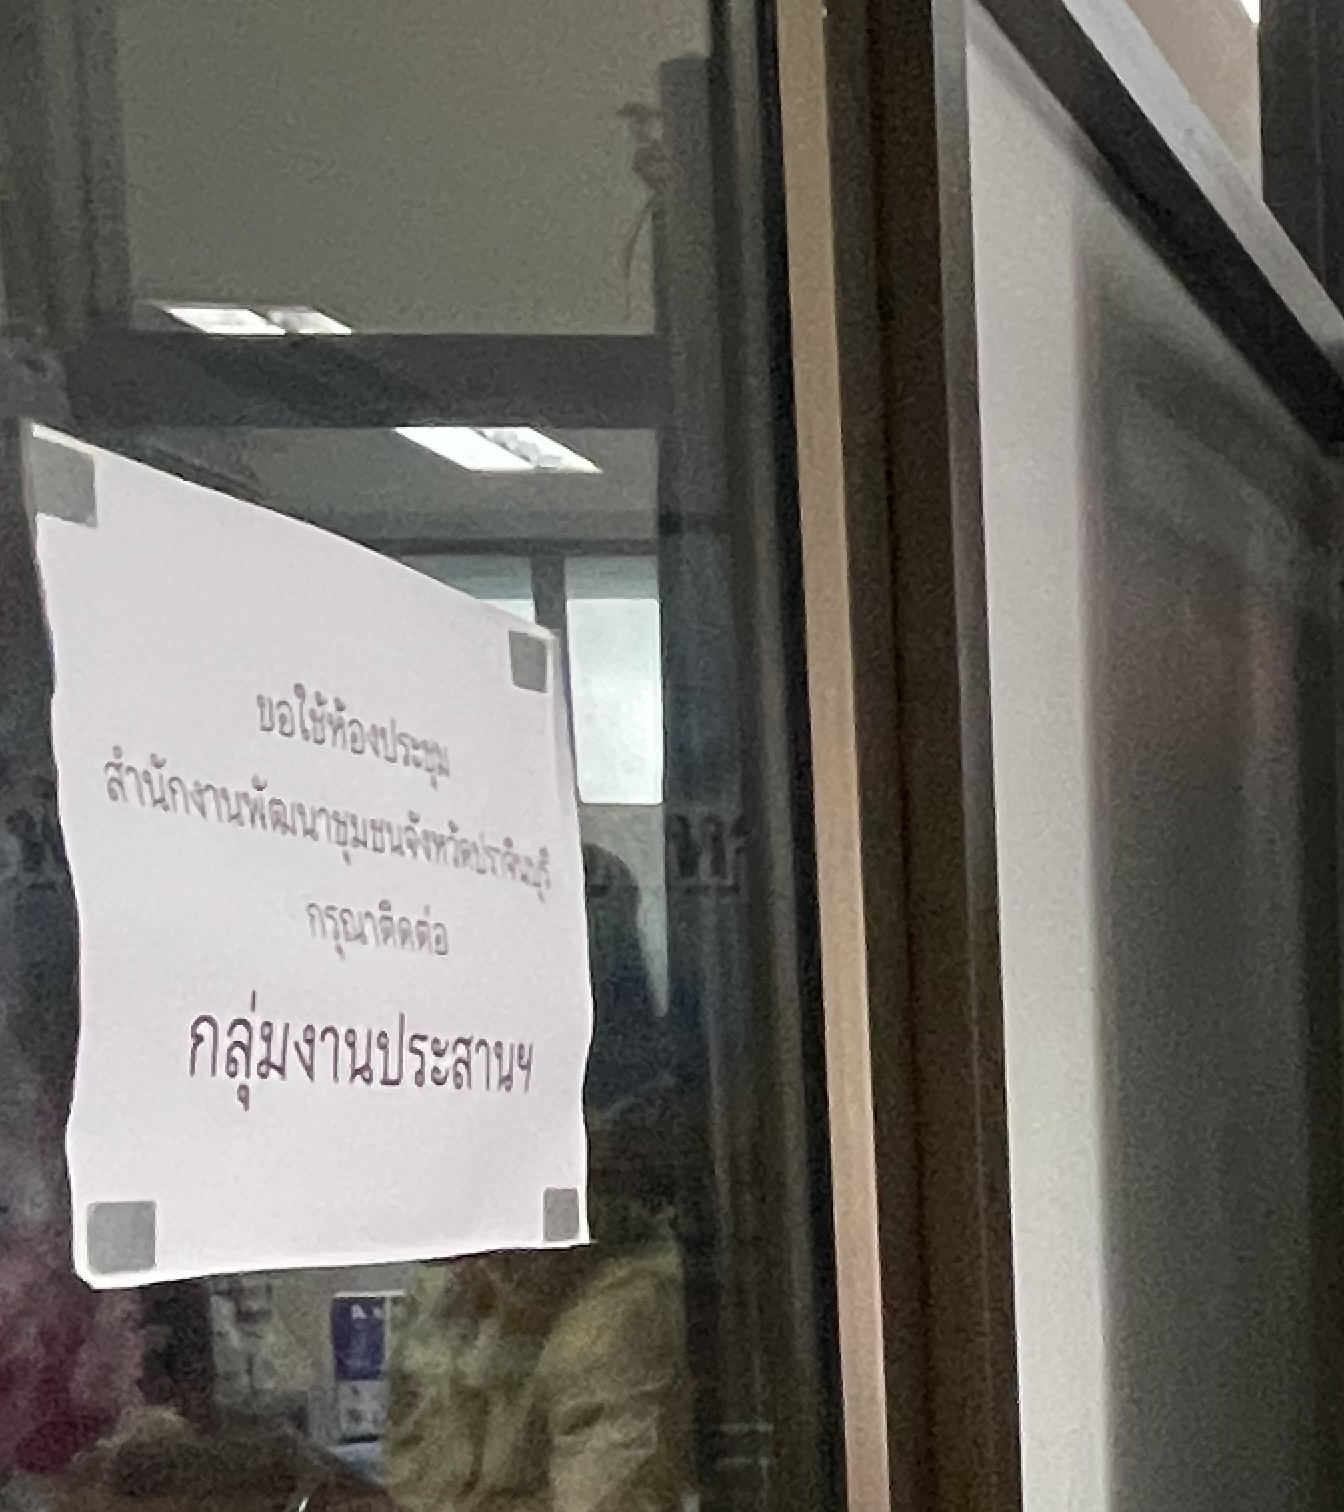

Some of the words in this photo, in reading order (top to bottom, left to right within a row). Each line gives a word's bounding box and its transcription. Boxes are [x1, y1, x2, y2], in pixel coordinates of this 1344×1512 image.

[256, 682, 450, 791] ขอใช้ห้องประชุม
[305, 897, 451, 962] กรุณาติดต่อ
[188, 986, 536, 1112] กลุ่มงานประสานฯ
